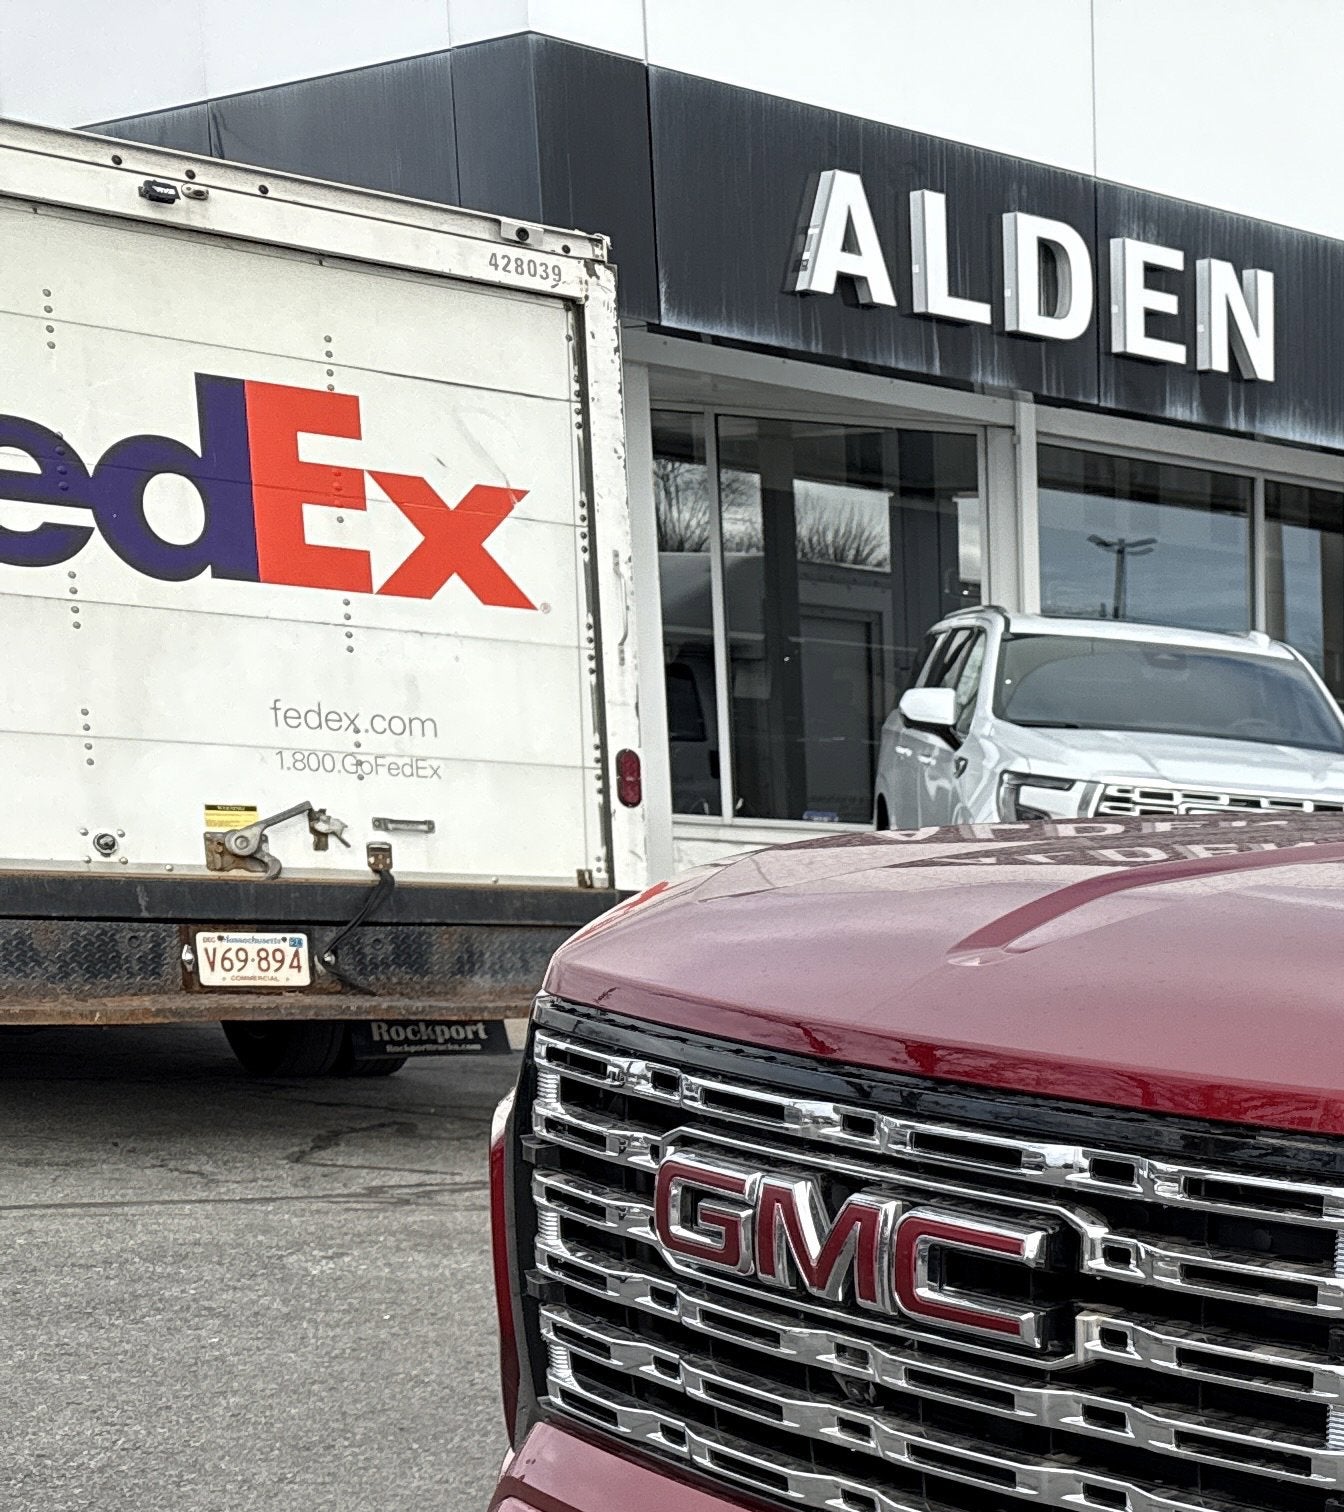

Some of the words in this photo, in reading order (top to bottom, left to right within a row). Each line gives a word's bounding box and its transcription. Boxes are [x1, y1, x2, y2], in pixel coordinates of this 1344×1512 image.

[489, 253, 562, 283] 428039
[795, 168, 1275, 382] ALDEN
[0, 372, 538, 611] edEx
[270, 699, 437, 738] fedex.com
[276, 751, 442, 780] 1.800.GoFedEx
[371, 1022, 488, 1043] Rockport
[655, 1150, 1060, 1351] GMC
